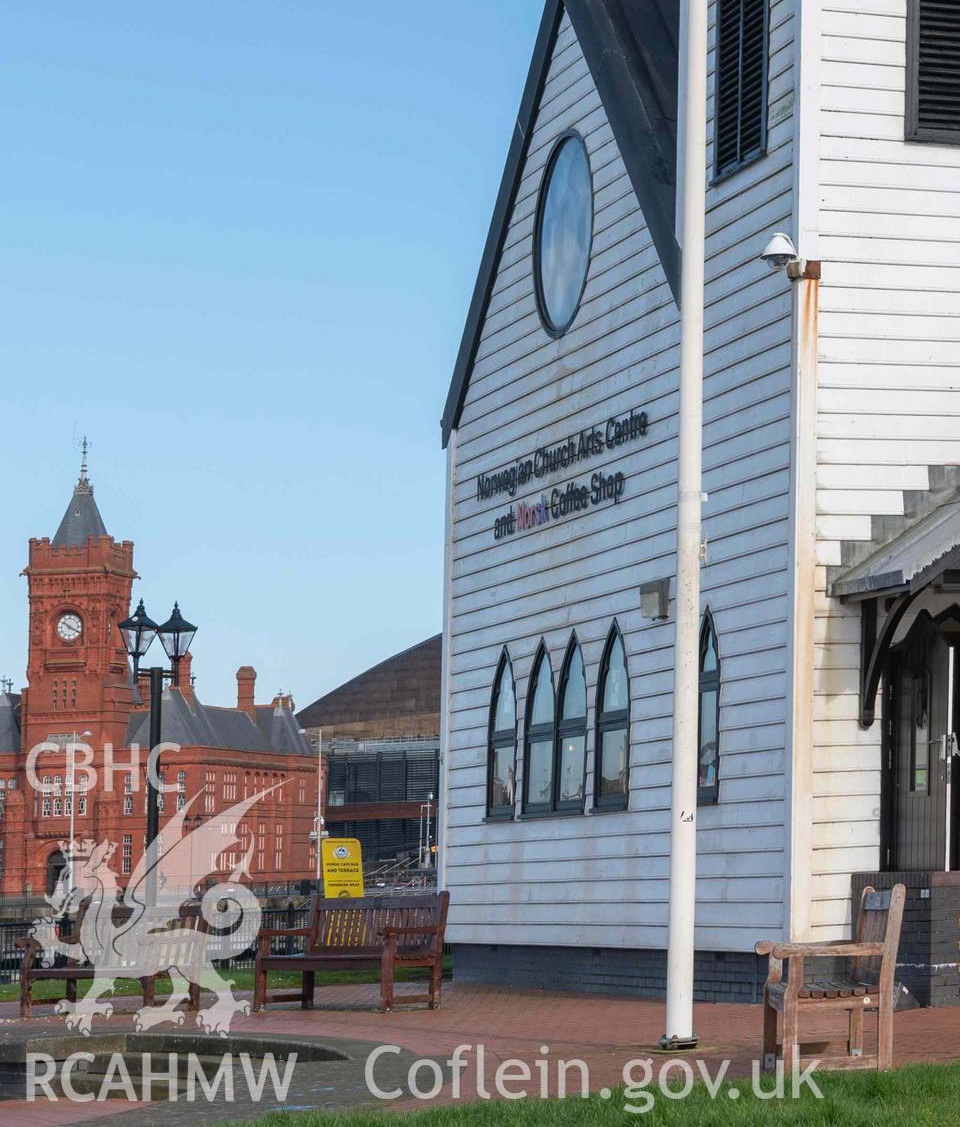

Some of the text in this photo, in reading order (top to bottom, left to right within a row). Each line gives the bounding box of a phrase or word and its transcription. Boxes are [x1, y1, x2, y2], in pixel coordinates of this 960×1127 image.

[476, 409, 648, 502] Norwegian Church Arts Centre
[494, 471, 625, 540] and Norsk Coffee Shop
